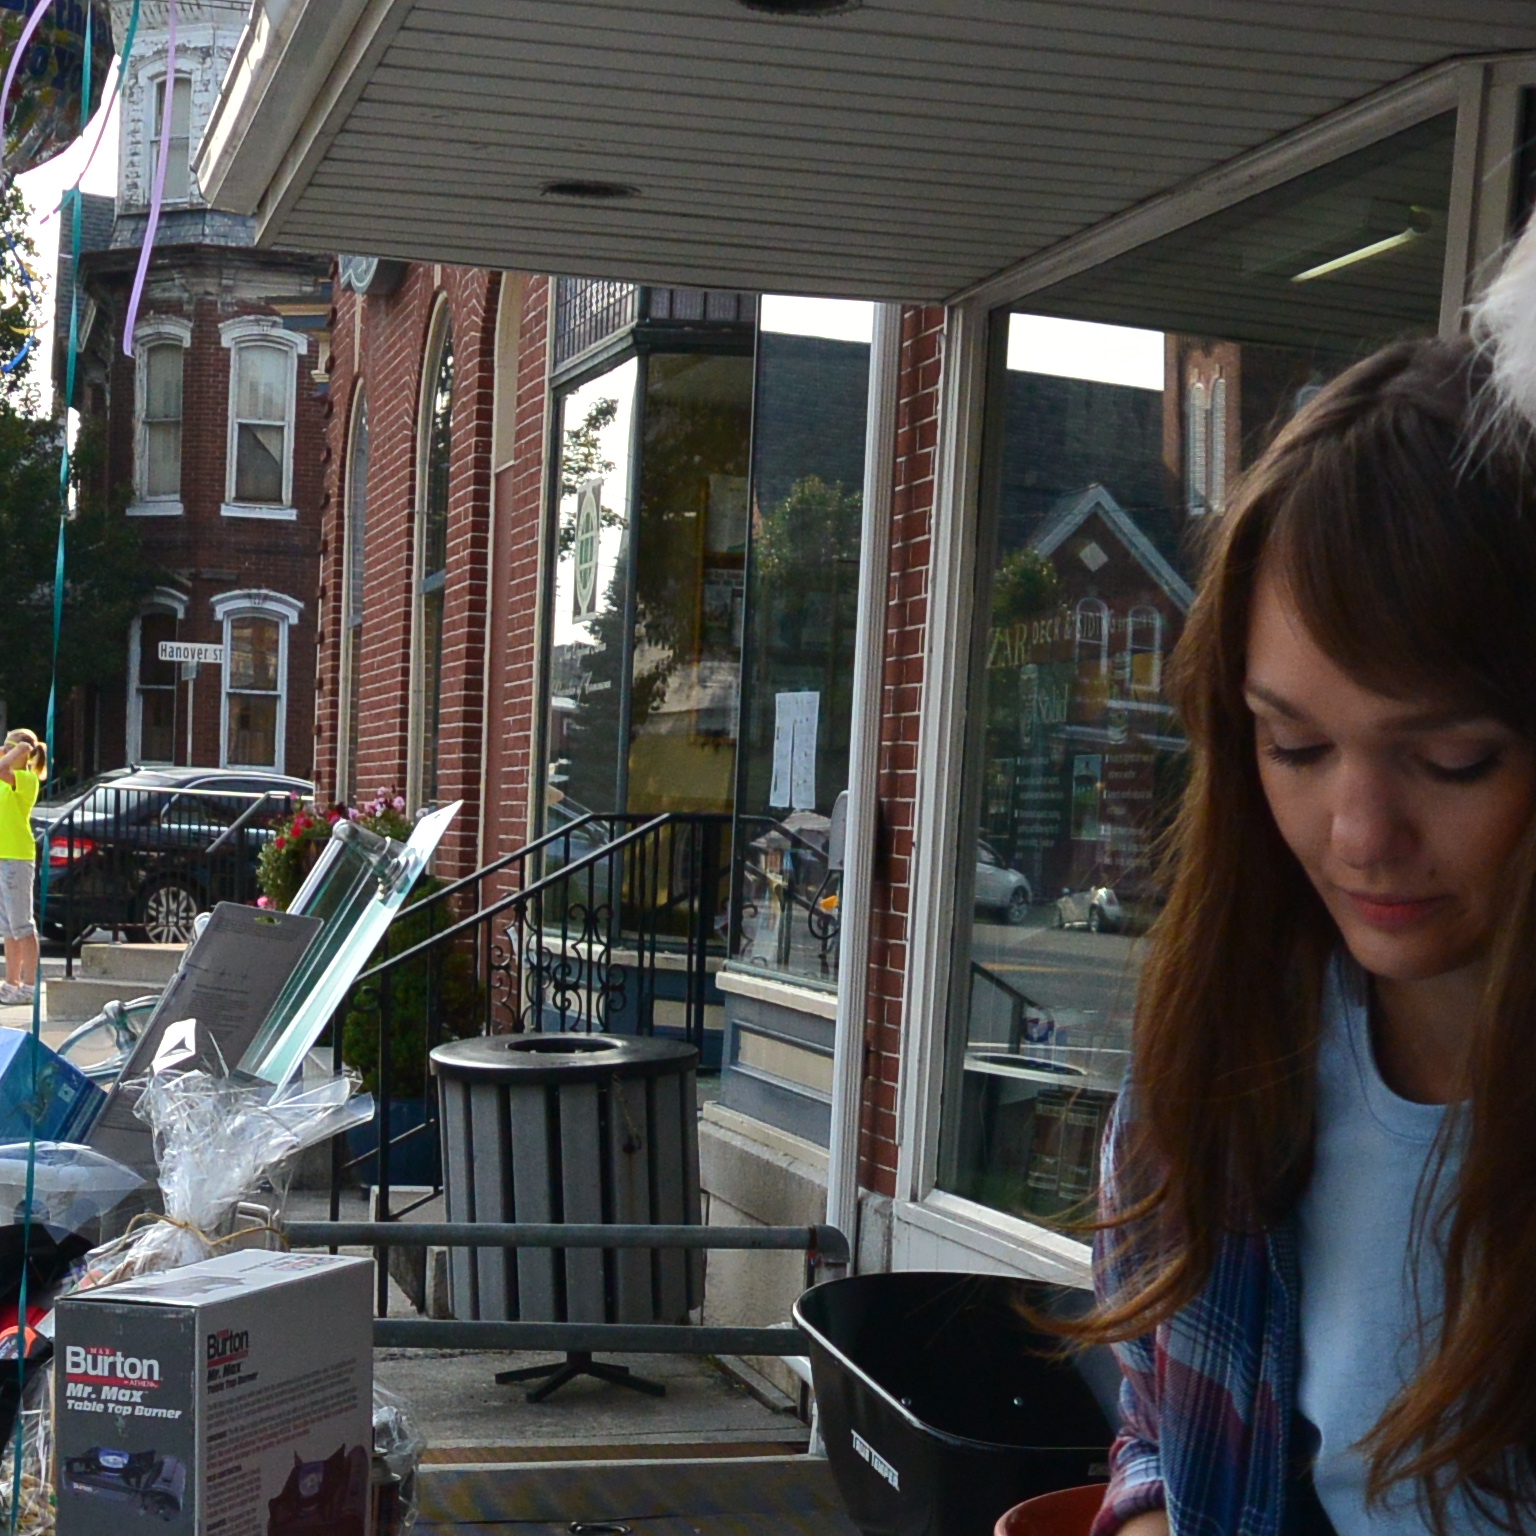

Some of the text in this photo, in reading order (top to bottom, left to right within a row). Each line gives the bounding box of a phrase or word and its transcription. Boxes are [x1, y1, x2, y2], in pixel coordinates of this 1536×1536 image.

[160, 644, 208, 660] Hanover
[207, 1330, 249, 1359] Burton
[66, 1346, 160, 1380] Burton
[66, 1382, 144, 1402] Mr. Max
[66, 1400, 182, 1419] Table Top Burner
